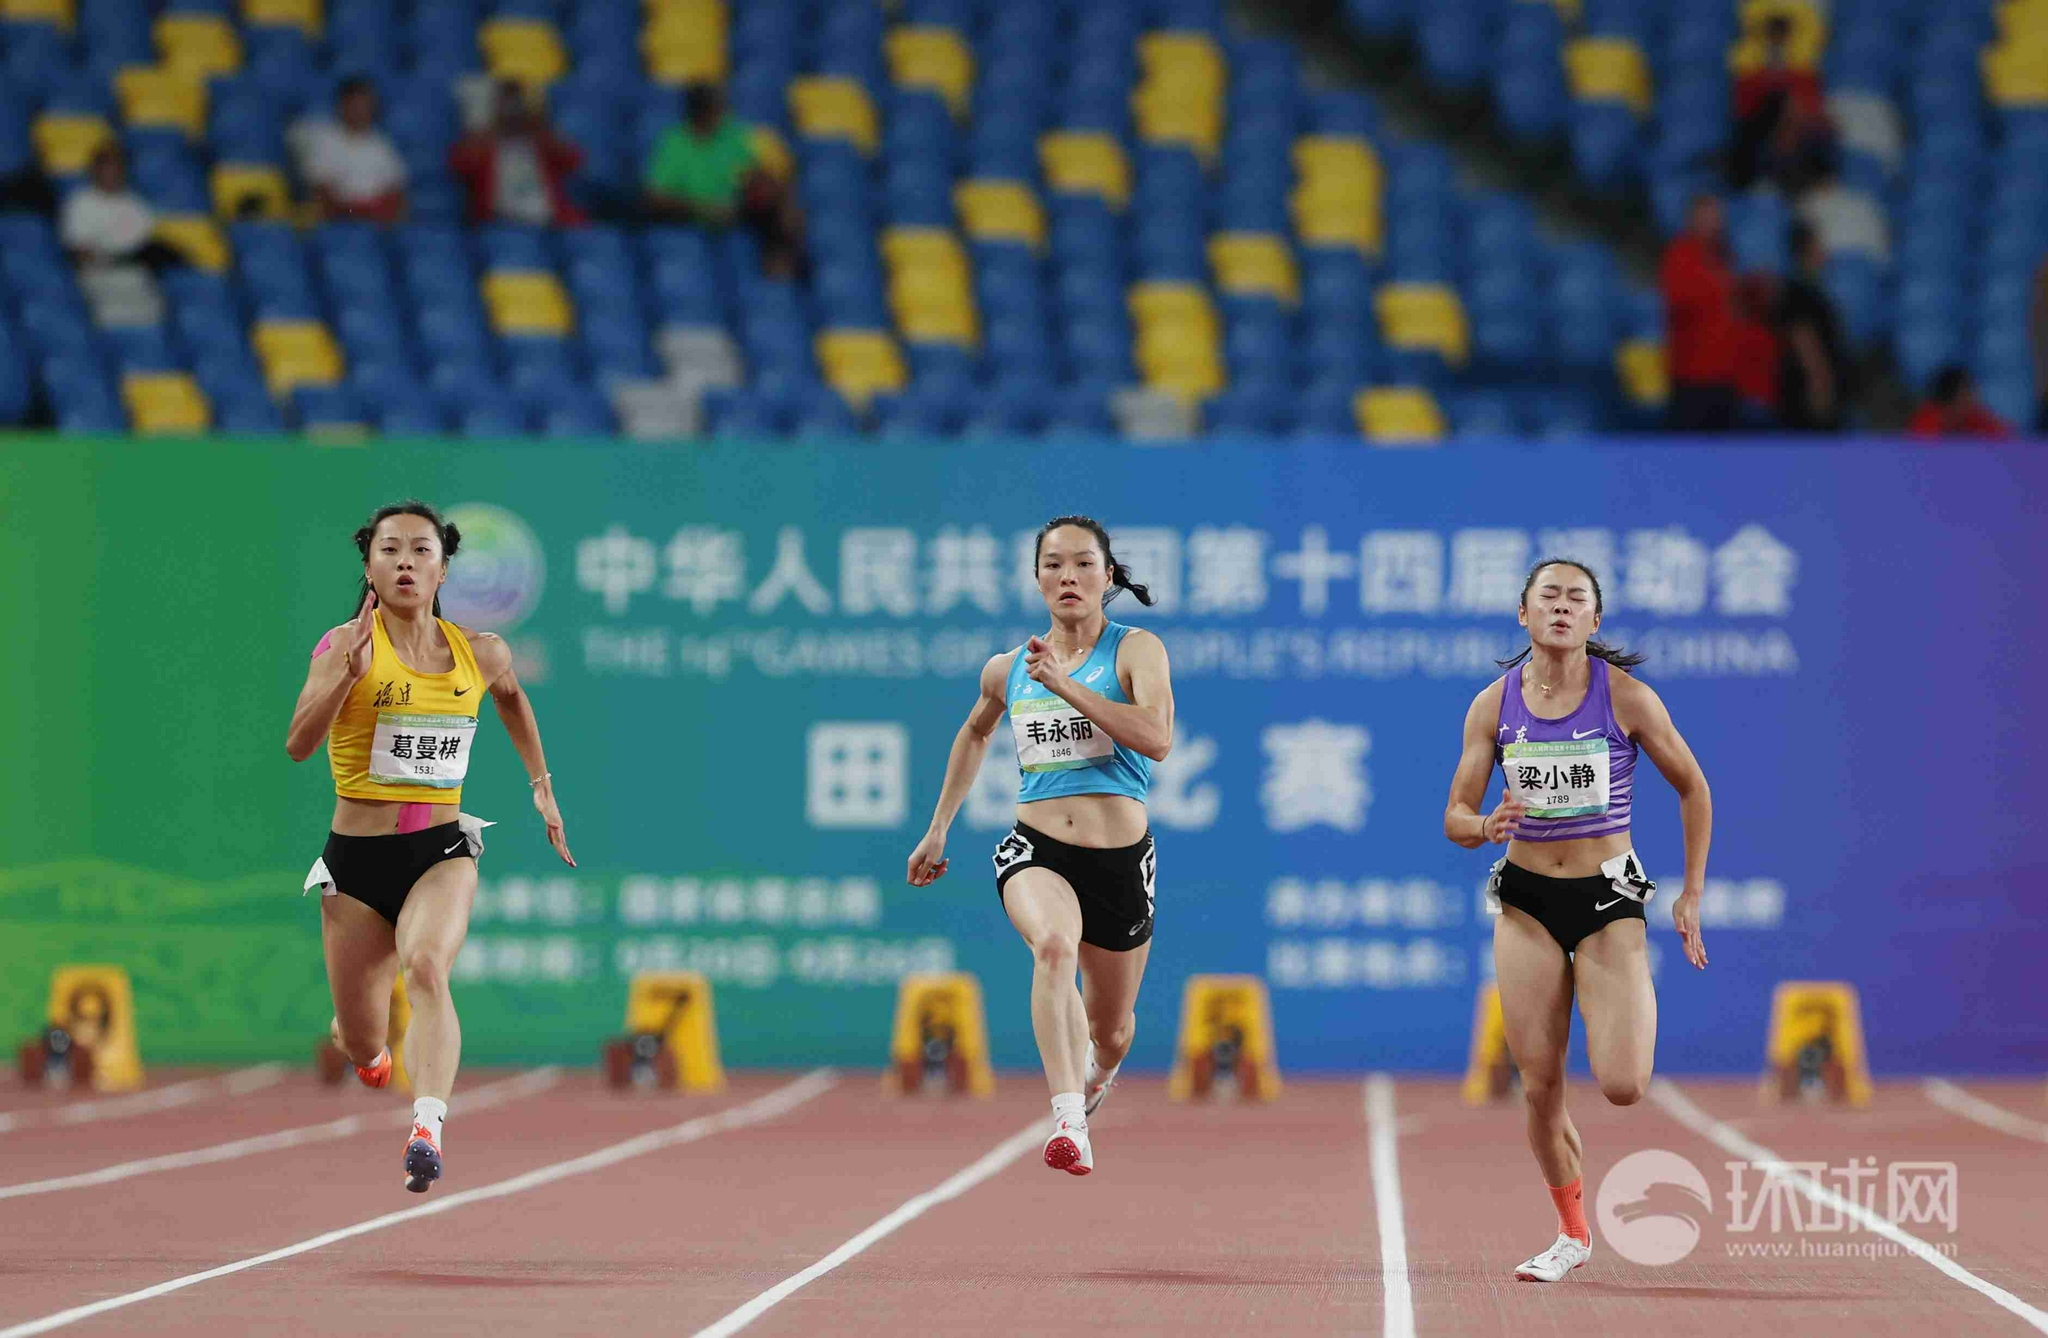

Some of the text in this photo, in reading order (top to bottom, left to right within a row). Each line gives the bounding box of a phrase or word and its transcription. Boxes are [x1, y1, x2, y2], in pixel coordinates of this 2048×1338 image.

[577, 525, 1797, 617] 中华人民共国第十四届动会
[1026, 716, 1094, 745] 韦永丽
[390, 735, 461, 760] 葛曼棋
[1051, 748, 1071, 758] 1846
[1518, 763, 1595, 790] 梁小静
[1546, 795, 1569, 805] 1789
[646, 984, 692, 1048] 7
